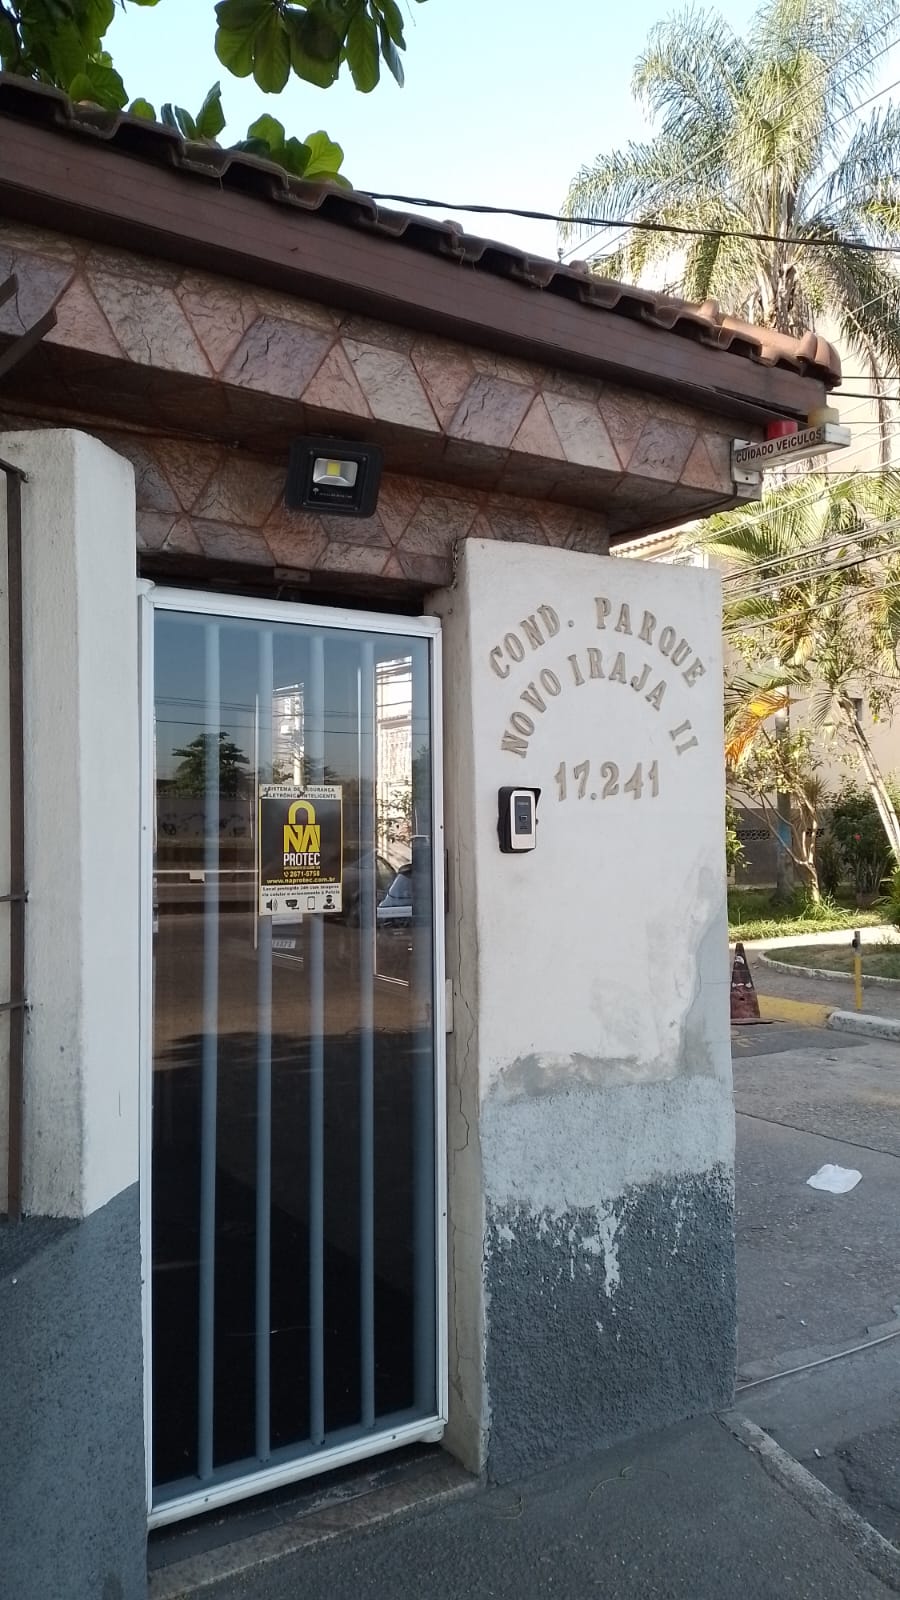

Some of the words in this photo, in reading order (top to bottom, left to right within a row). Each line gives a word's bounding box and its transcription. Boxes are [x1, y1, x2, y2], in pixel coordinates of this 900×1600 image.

[736, 444, 774, 463] CUIDADO
[489, 604, 575, 680] COND.
[594, 597, 706, 688] PARQUE
[501, 668, 562, 759] NOVO
[567, 647, 668, 712] IRAJA
[669, 719, 699, 756] II
[553, 759, 660, 802] 17.241
[283, 852, 320, 866] PROTEC
